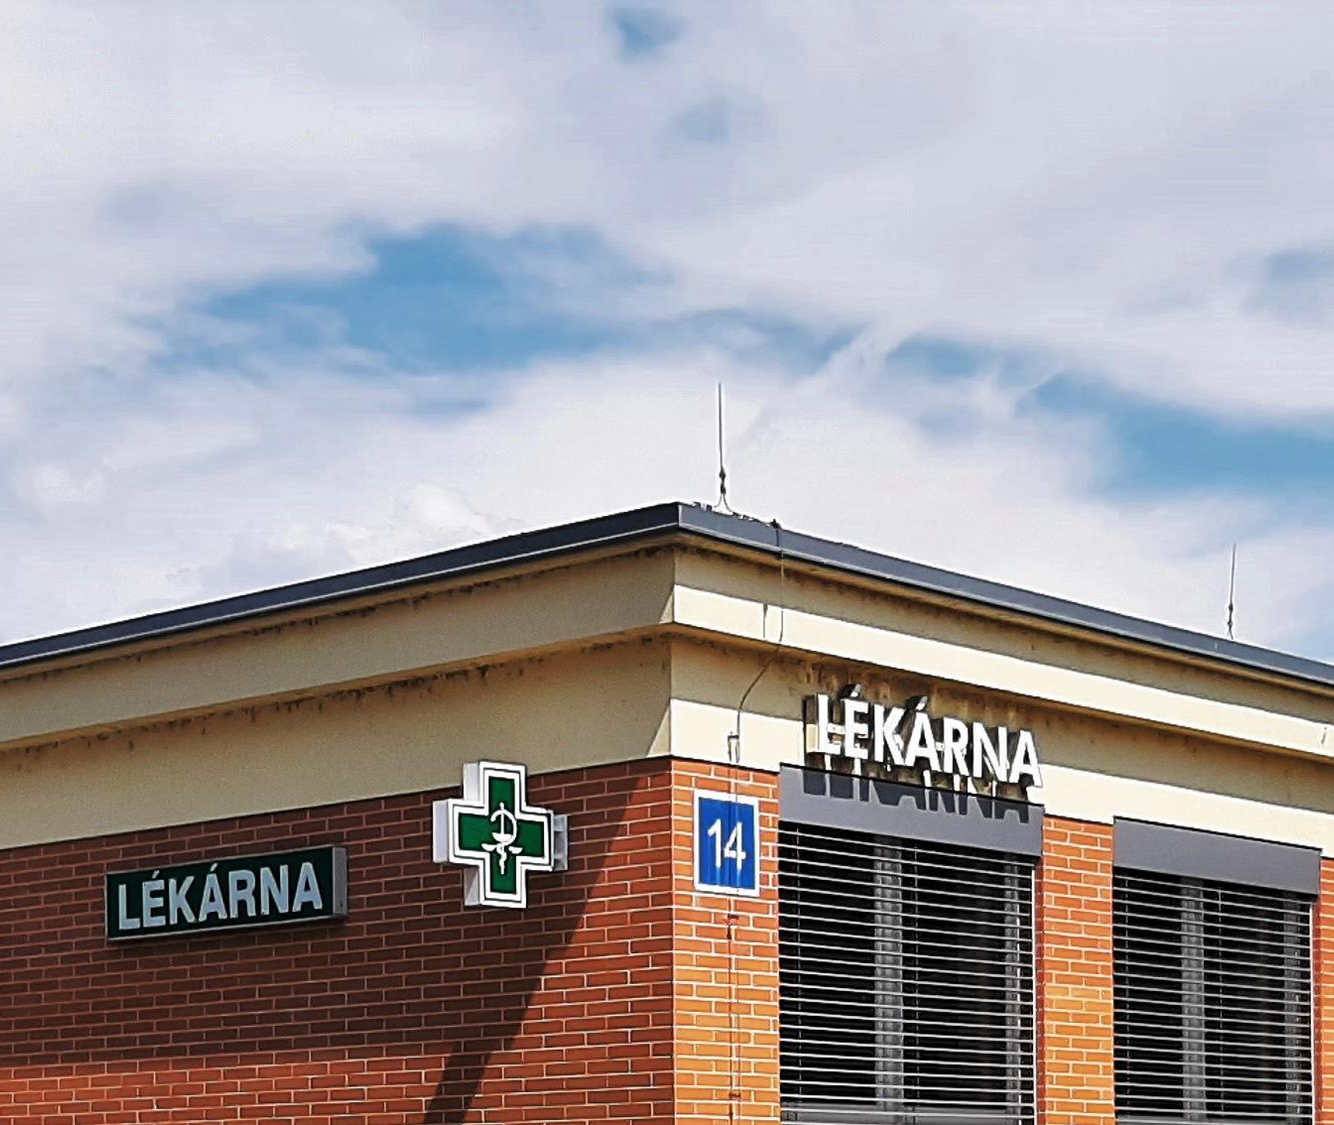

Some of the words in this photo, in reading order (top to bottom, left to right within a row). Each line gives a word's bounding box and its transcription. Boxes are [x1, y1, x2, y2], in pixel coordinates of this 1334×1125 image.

[815, 684, 1043, 787] LÉKÁRNA
[707, 818, 747, 870] 14
[118, 861, 323, 931] LÉKÁRNA
